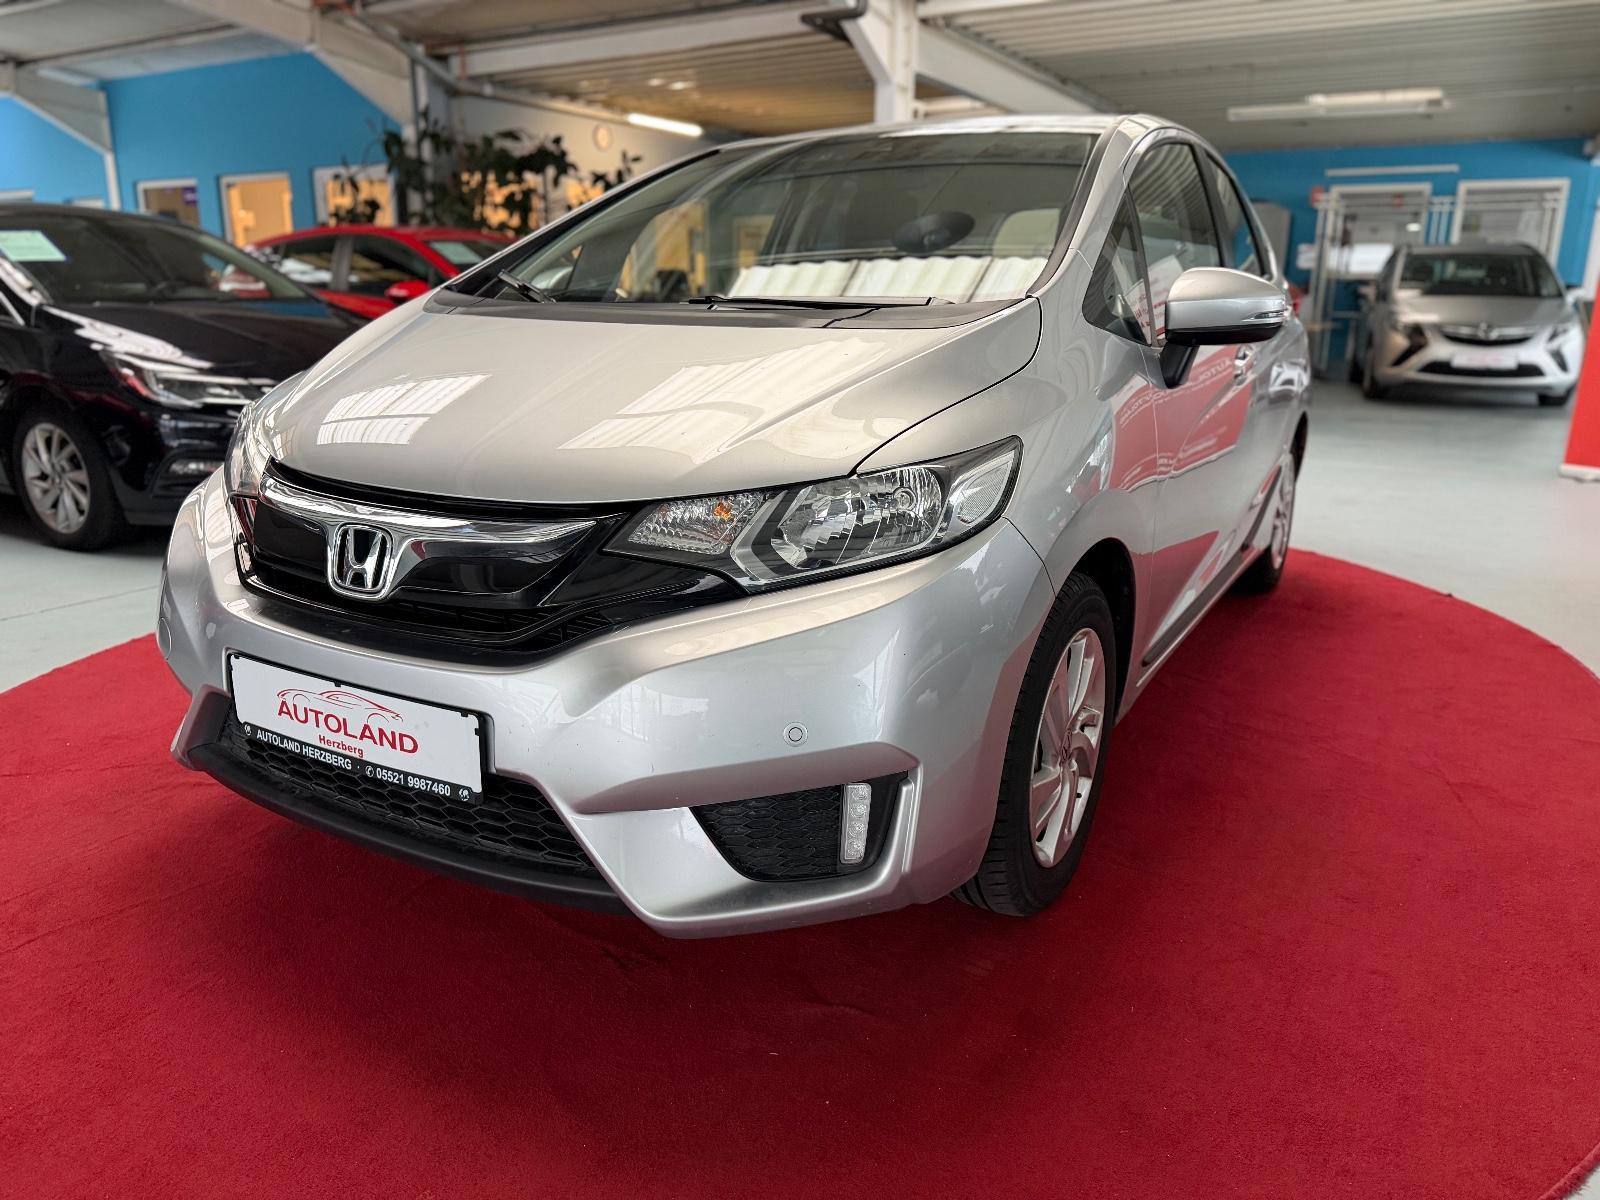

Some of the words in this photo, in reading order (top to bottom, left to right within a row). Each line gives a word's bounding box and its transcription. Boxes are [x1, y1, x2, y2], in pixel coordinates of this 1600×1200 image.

[277, 700, 419, 754] AUTOLAND
[318, 734, 364, 759] Herzberg
[256, 729, 300, 753] AUTOLAND
[302, 744, 352, 770] HERZBERG
[376, 767, 404, 785] 05521
[407, 775, 451, 797] 9987460
